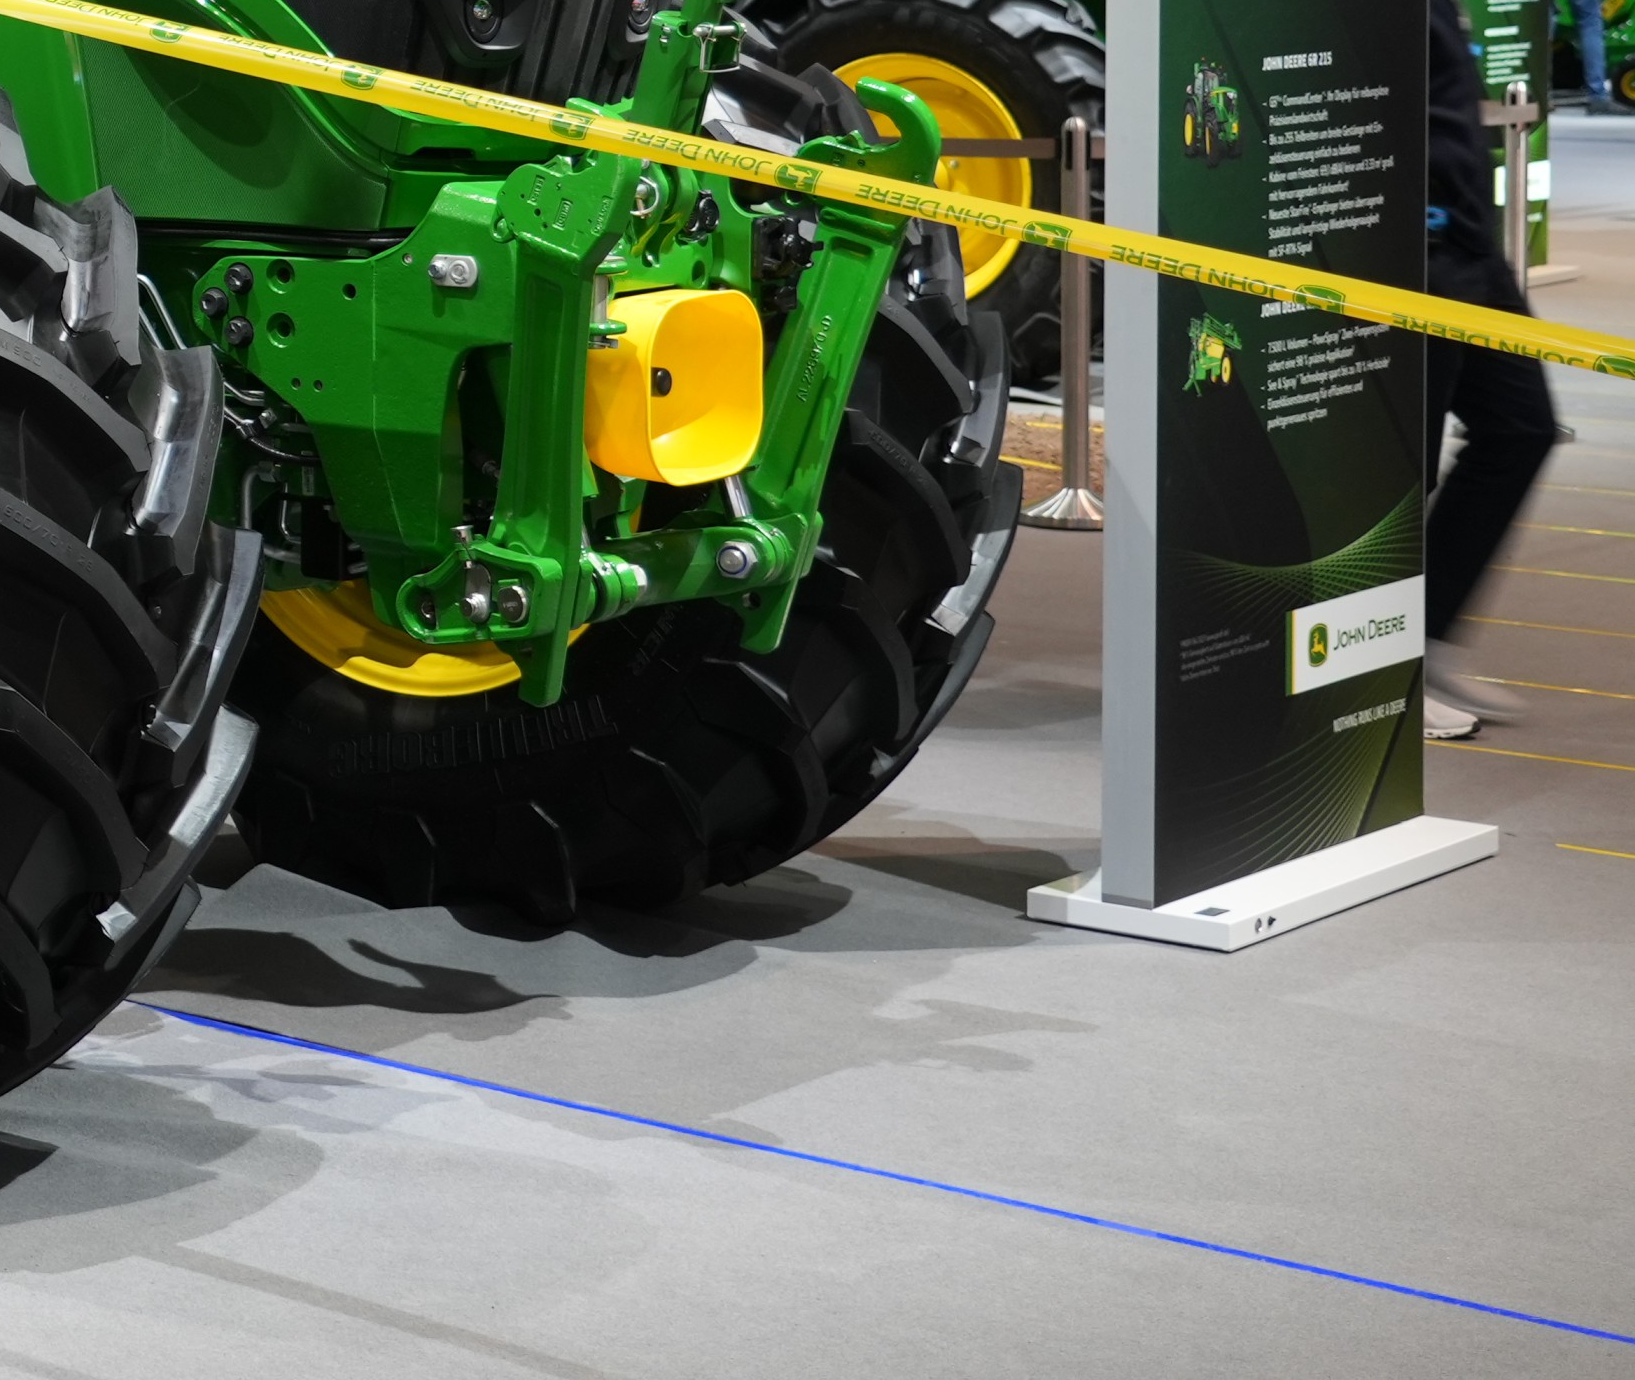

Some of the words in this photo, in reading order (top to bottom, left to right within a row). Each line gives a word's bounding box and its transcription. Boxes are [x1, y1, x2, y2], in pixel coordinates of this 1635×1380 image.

[97, 7, 156, 26] JOHN
[1262, 56, 1283, 71] JOHN
[1283, 53, 1308, 69] DEERE
[1318, 51, 1333, 66] 215
[410, 79, 483, 109] DEERE
[485, 97, 551, 122] JOHN
[622, 128, 702, 161] DEERE
[703, 147, 773, 176] JOHN
[855, 183, 941, 219] DEERE
[944, 204, 1018, 235] JOHN
[1109, 244, 1203, 281] DEERE
[1207, 271, 1289, 299] JOHN
[1391, 312, 1491, 349] DEERE
[1333, 624, 1366, 652] JOHN
[1368, 614, 1407, 643] DEERE
